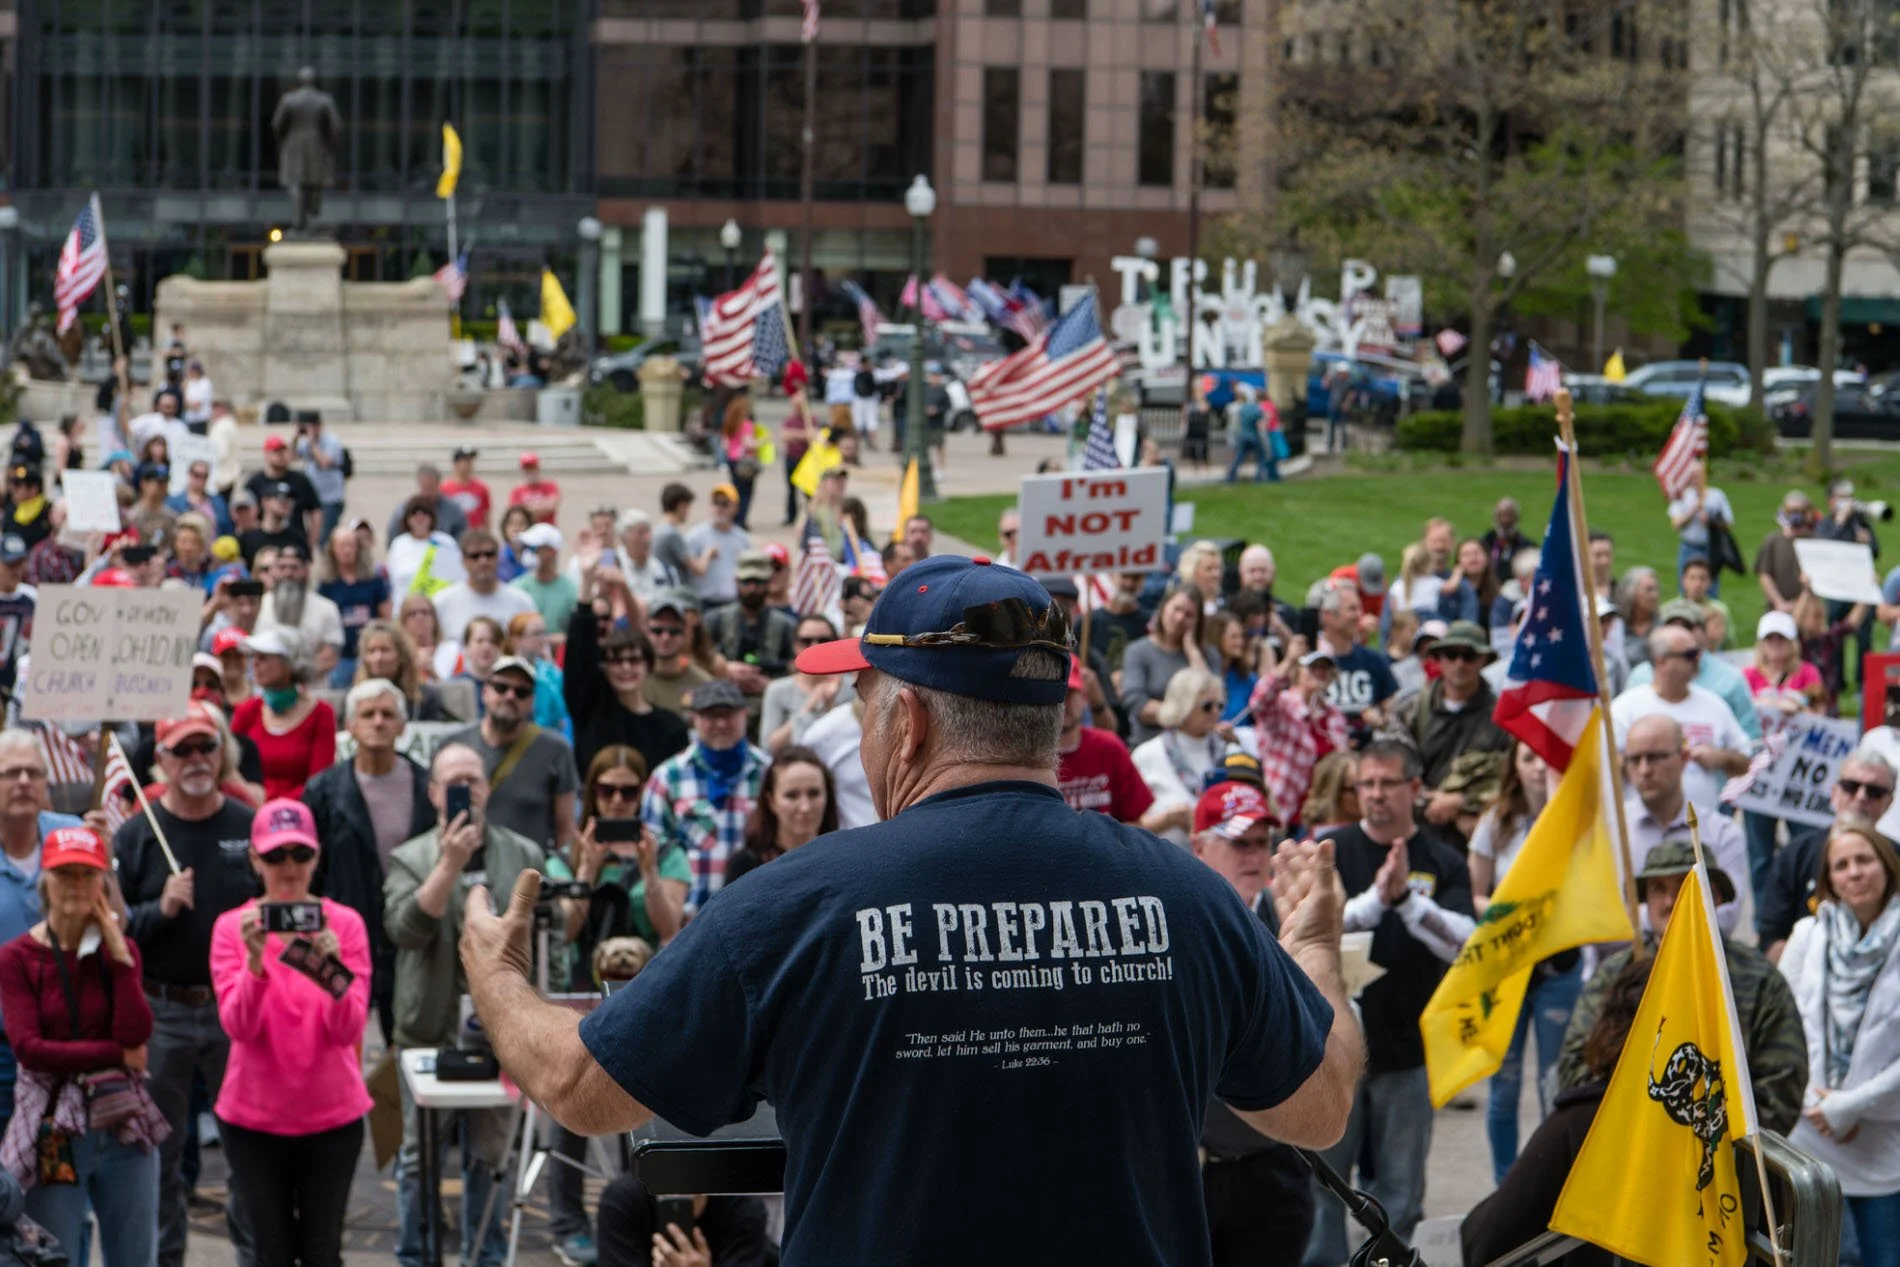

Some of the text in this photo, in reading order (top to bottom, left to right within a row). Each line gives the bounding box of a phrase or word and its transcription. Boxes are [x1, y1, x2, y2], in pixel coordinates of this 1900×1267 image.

[1061, 478, 1127, 500] I'm
[1045, 508, 1141, 537] NOT
[1023, 543, 1157, 573] Afraid
[1791, 756, 1828, 785] NO
[856, 896, 1170, 973] BE PREPARED
[863, 956, 1173, 1000] The devil is coming to church!
[937, 1045, 952, 1057] let
[956, 1044, 978, 1056] him
[981, 1042, 1001, 1054] sell
[1005, 1041, 1020, 1053] his
[1076, 1037, 1097, 1049] and
[1100, 1036, 1123, 1048] buy
[941, 1030, 966, 1043] said
[970, 1029, 986, 1042] He
[990, 1028, 1016, 1040] unto
[1019, 1025, 1067, 1038] them...he
[1072, 1024, 1094, 1036] that
[1097, 1021, 1122, 1034] hath
[1126, 1023, 1141, 1032] no
[1001, 1059, 1023, 1070] Luke
